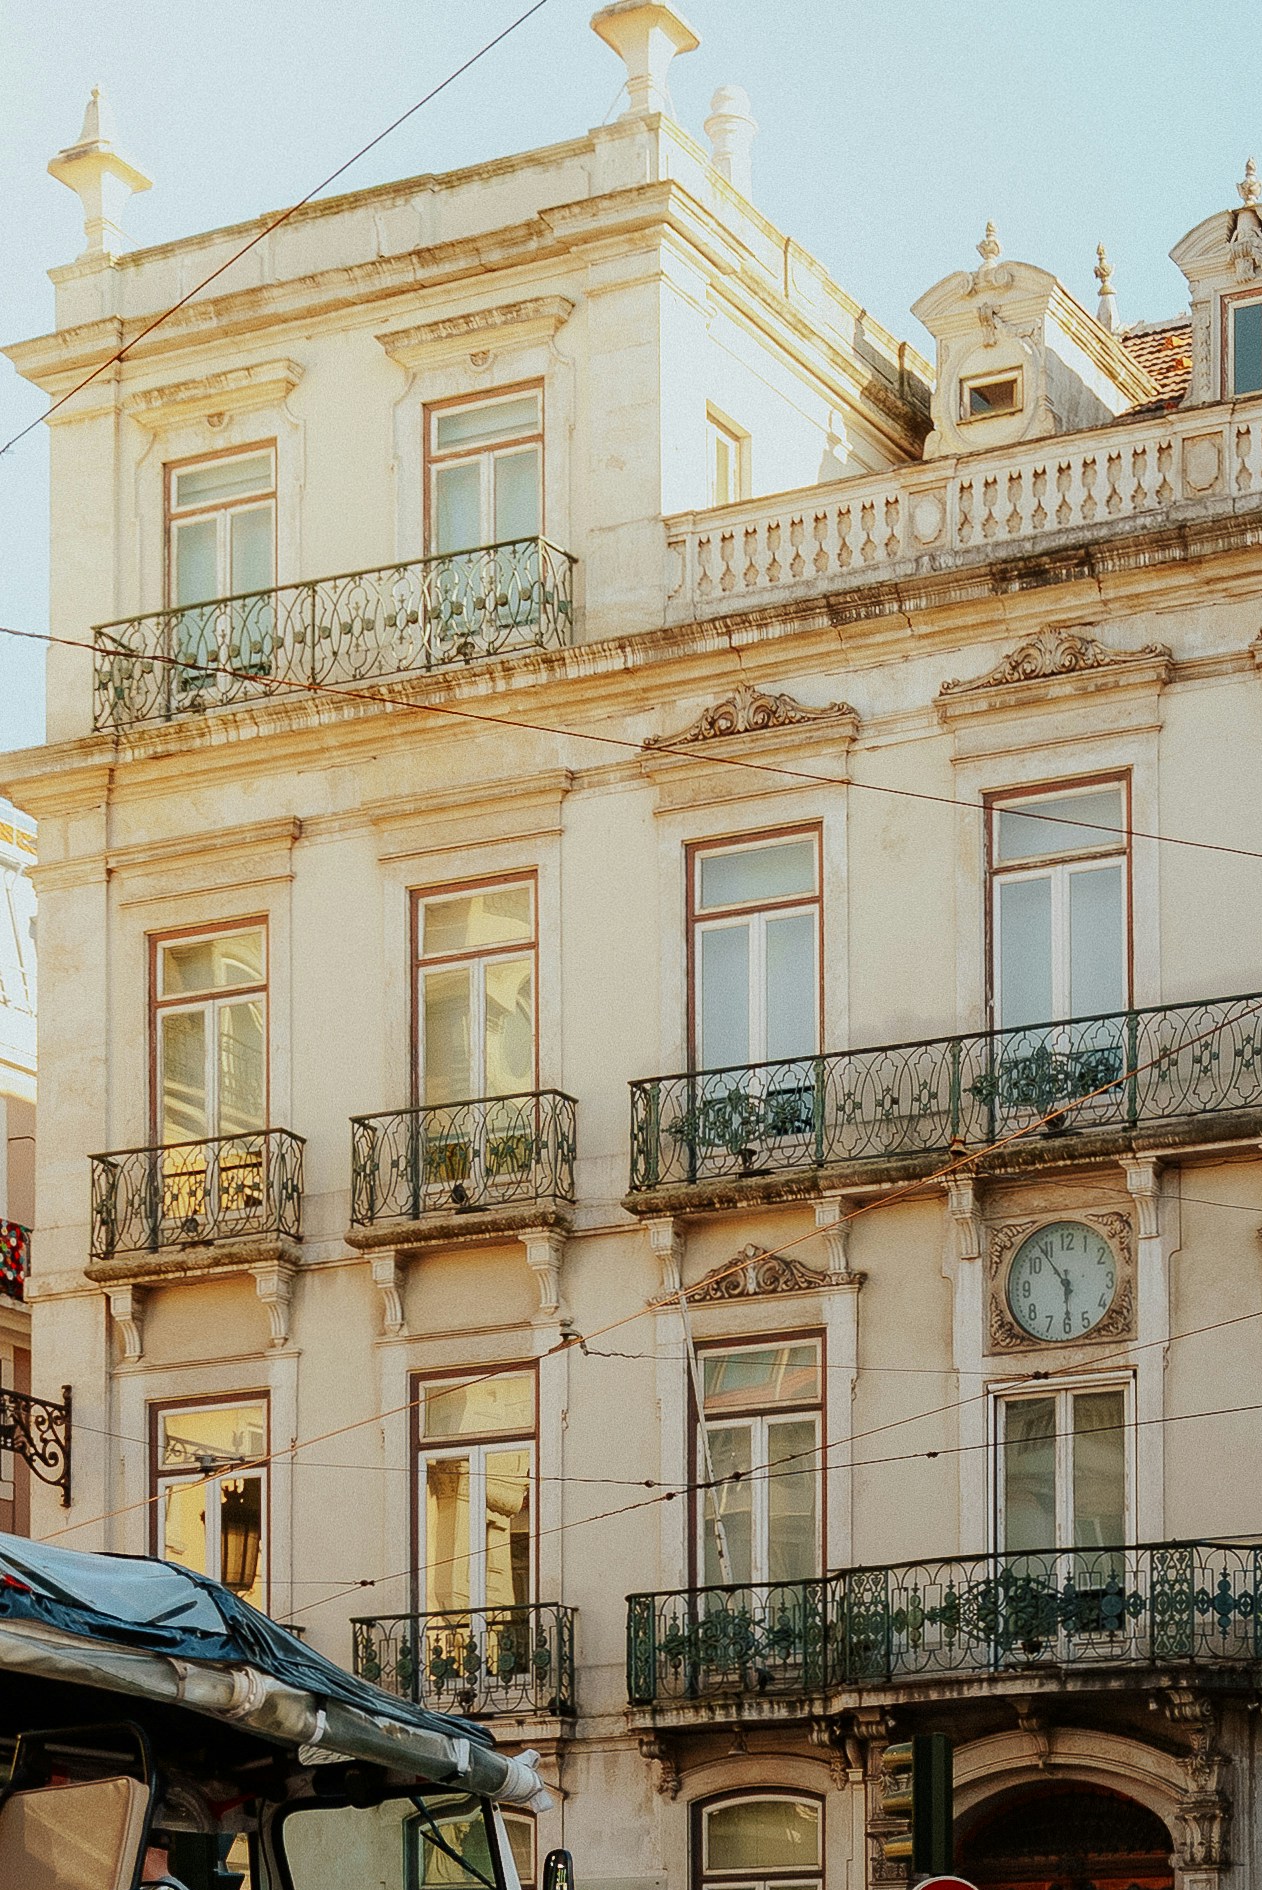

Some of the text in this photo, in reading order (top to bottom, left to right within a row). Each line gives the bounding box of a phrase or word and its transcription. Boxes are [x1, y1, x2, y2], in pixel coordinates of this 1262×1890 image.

[1060, 1233, 1074, 1251] 12
[1097, 1247, 1105, 1265] 2
[1028, 1257, 1042, 1275] 10
[1022, 1280, 1031, 1298] 9
[1105, 1271, 1114, 1289] 3
[1098, 1292, 1107, 1310] 4
[1028, 1303, 1037, 1321] 8
[1081, 1311, 1091, 1329] 5
[1045, 1315, 1054, 1333] 7
[1063, 1315, 1072, 1334] 6
